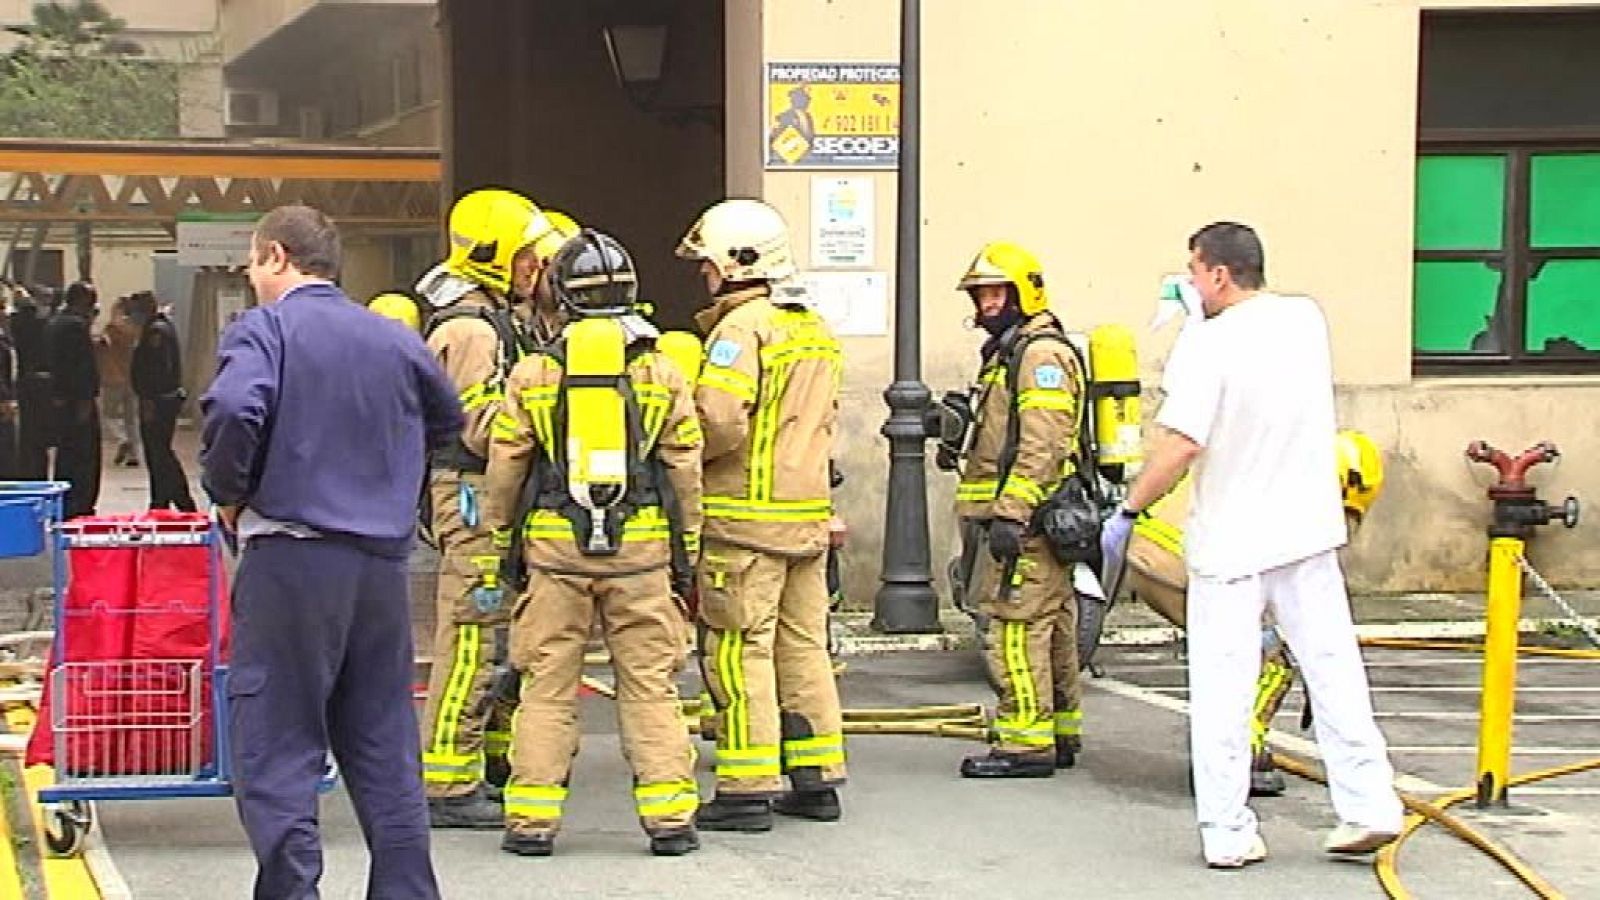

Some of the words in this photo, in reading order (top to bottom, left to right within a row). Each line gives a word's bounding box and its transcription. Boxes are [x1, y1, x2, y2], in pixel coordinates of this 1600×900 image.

[771, 67, 838, 80] PROPIEDAD
[840, 67, 900, 80] PROTEGID
[835, 114, 857, 132] 902
[811, 138, 900, 154] SECOEX
